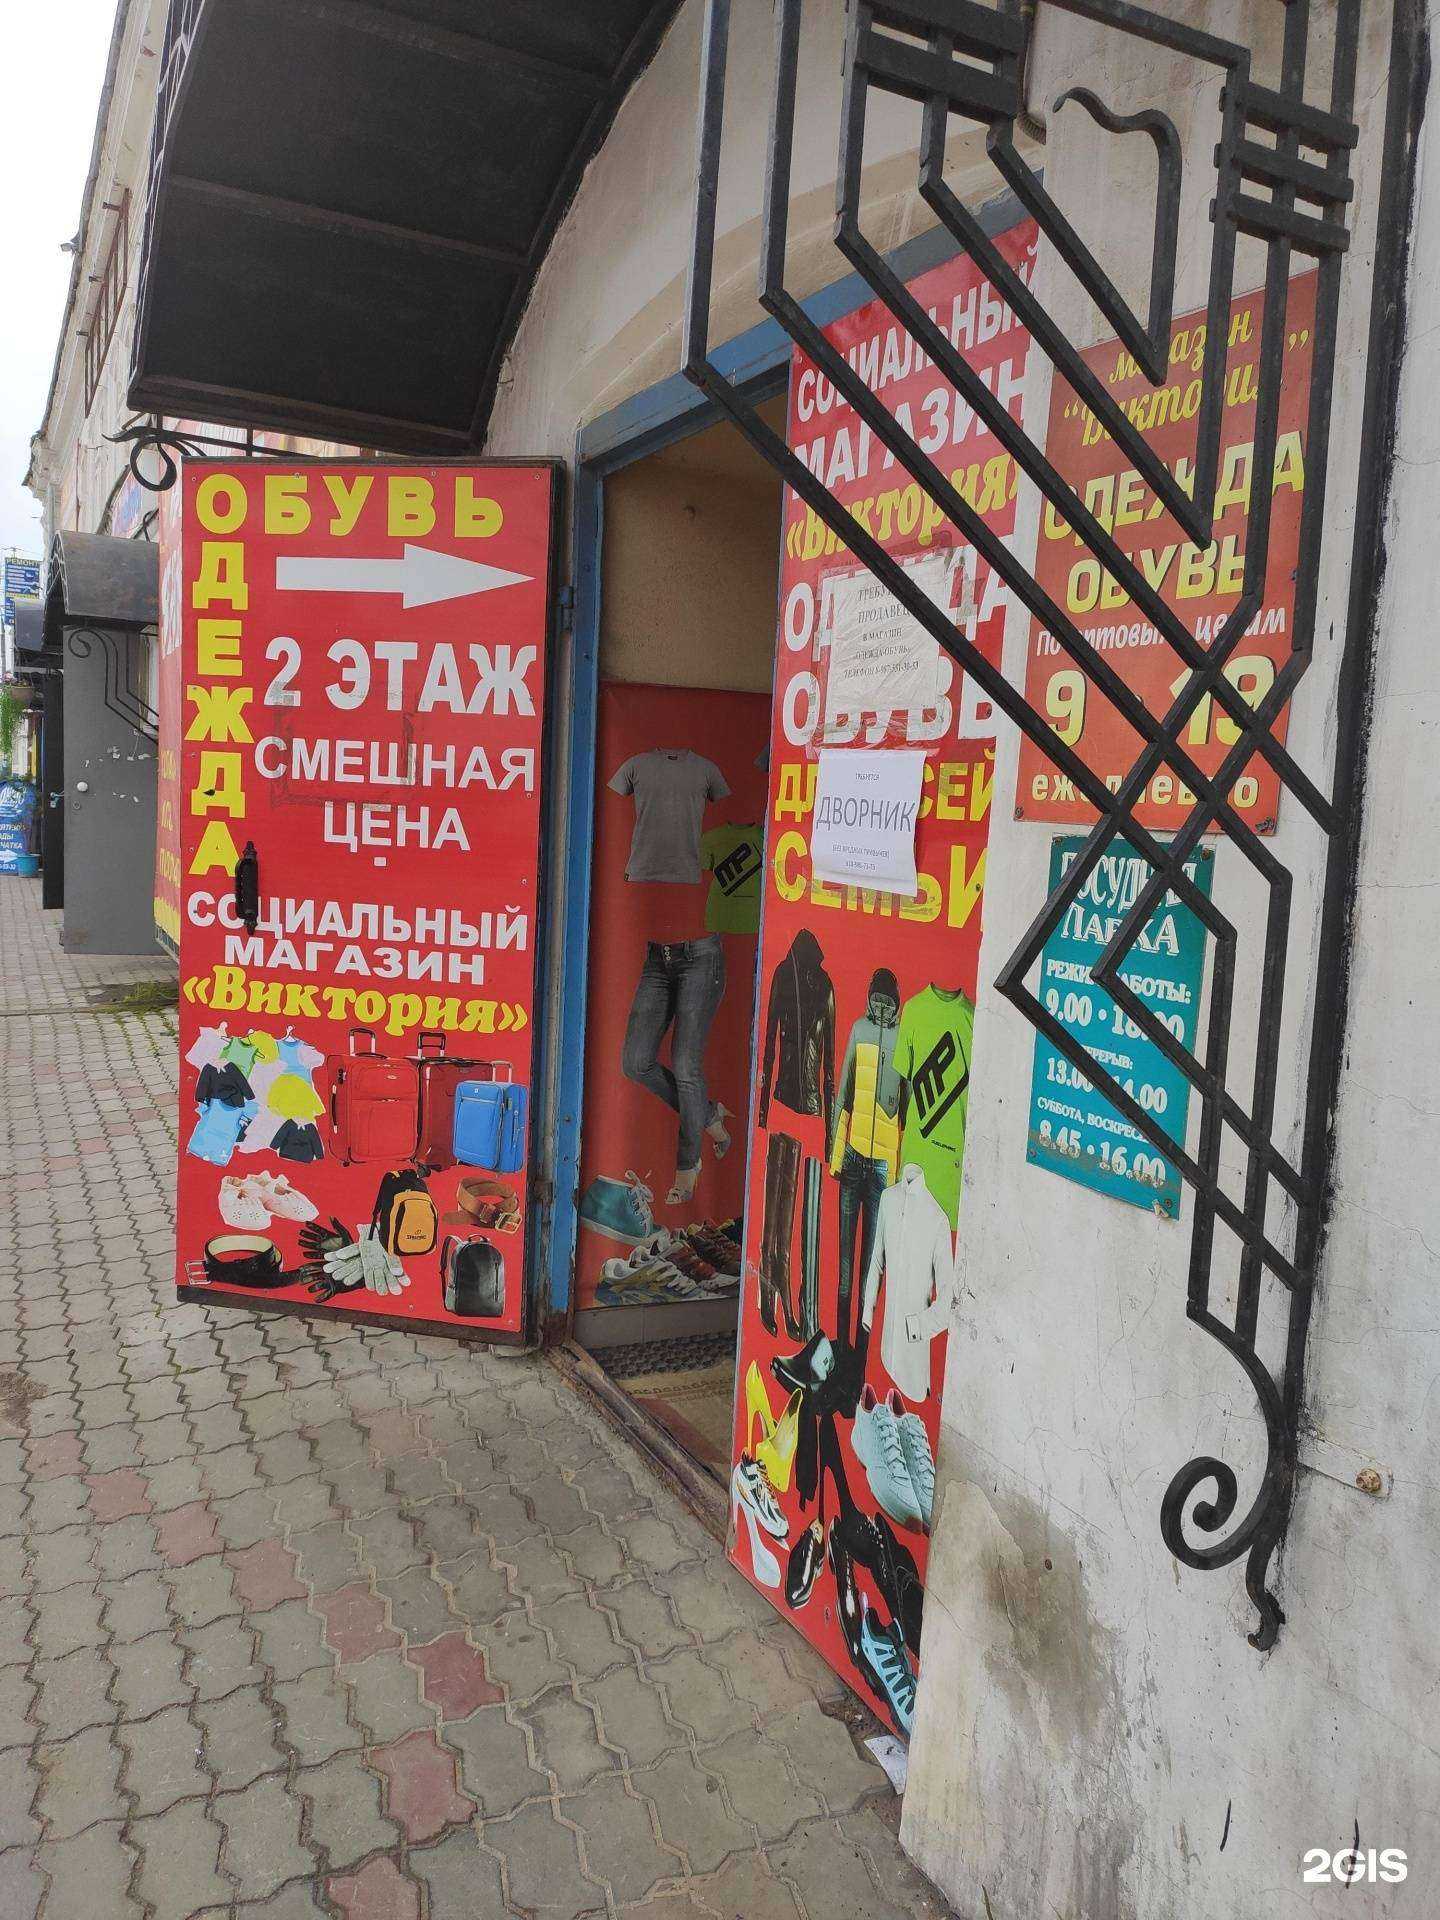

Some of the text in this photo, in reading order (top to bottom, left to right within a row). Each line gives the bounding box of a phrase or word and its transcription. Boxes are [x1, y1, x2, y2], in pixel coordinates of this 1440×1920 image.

[195, 473, 504, 538] ОБУВЬ
[1195, 607, 1286, 645] цеам
[184, 473, 255, 878] ОДЕЖДА
[263, 636, 537, 716] 2 ЭТАЖ
[1046, 670, 1087, 747] 9
[254, 735, 535, 792] СМЕШНАЯ
[324, 801, 471, 853] ЦЕНА
[816, 796, 915, 832] ДВОРНИК
[187, 890, 529, 951] СОЦИАЛЬНЫЙ
[225, 935, 485, 985] МАГАЗИН
[1046, 958, 1192, 1004] РЕЖИ АБОТЫ:
